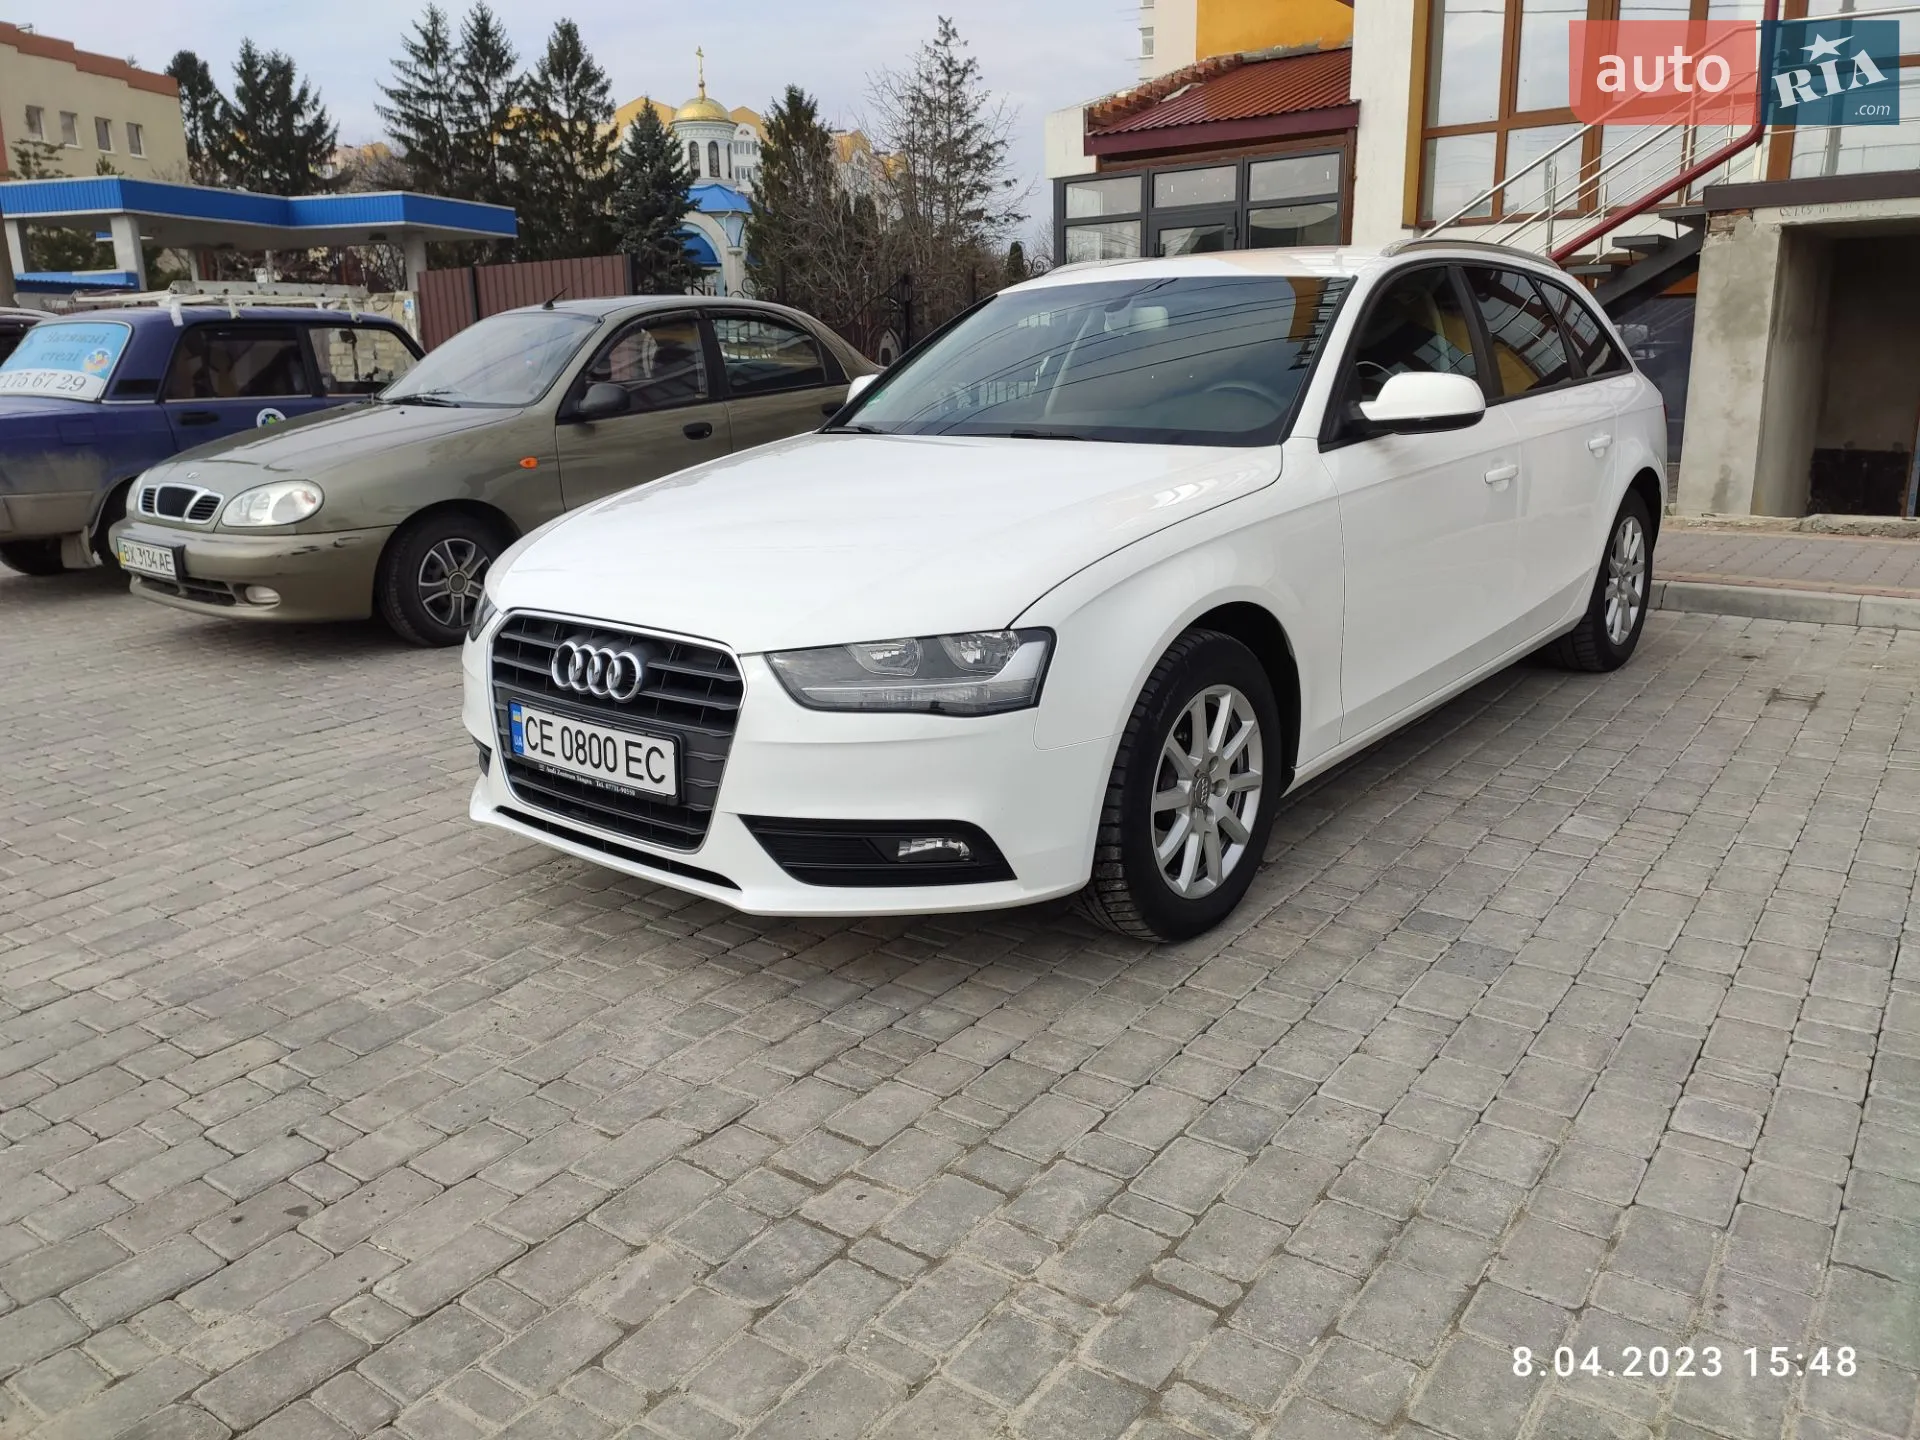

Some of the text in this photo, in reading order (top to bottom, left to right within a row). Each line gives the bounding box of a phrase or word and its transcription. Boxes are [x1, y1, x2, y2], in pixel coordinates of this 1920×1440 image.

[32, 371, 58, 389] 67
[56, 373, 87, 392] 29
[123, 544, 174, 573] BX 3134 AE
[514, 736, 523, 748] UA
[525, 715, 667, 784] CE 0800 EC
